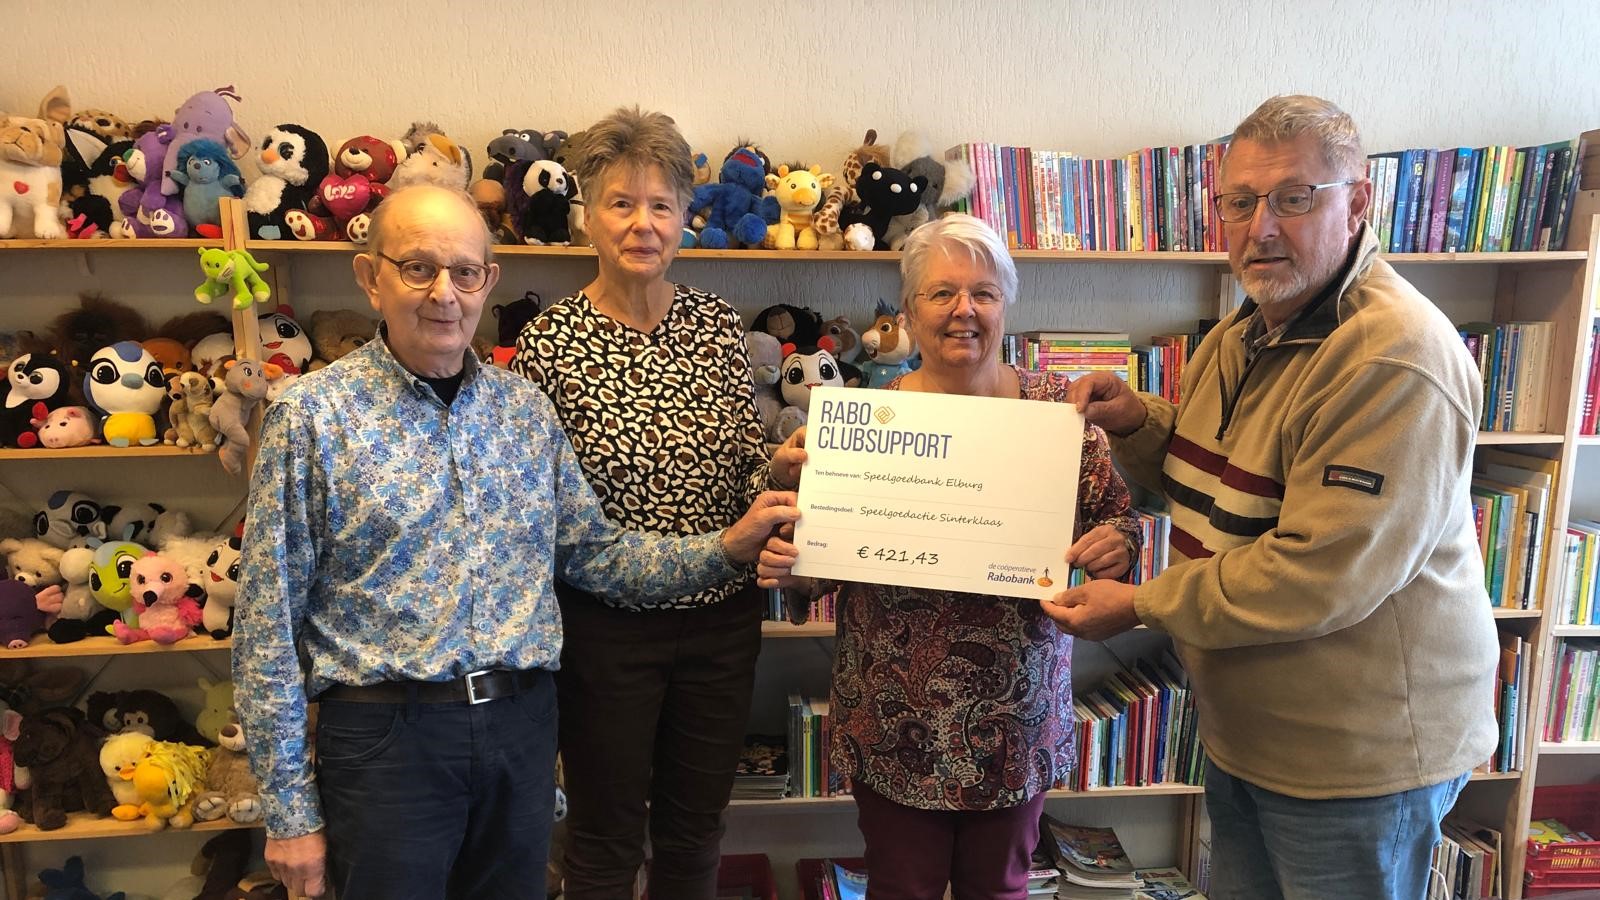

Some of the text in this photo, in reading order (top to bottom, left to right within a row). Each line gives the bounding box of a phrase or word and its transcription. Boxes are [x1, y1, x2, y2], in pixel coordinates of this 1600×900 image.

[820, 400, 872, 425] RABO
[818, 426, 952, 459] CLUBSUPPORT
[815, 469, 825, 477] Ten
[825, 469, 849, 478] behoeve
[863, 471, 944, 486] Speelgoedbank
[945, 478, 983, 492] Elburg
[810, 503, 1004, 528] Bestedingsdoel: Speelgoedactie Sinterklaas
[806, 540, 940, 566] Bedrag: € 421,43
[987, 571, 1036, 585] Rabobank
[988, 562, 997, 570] de
